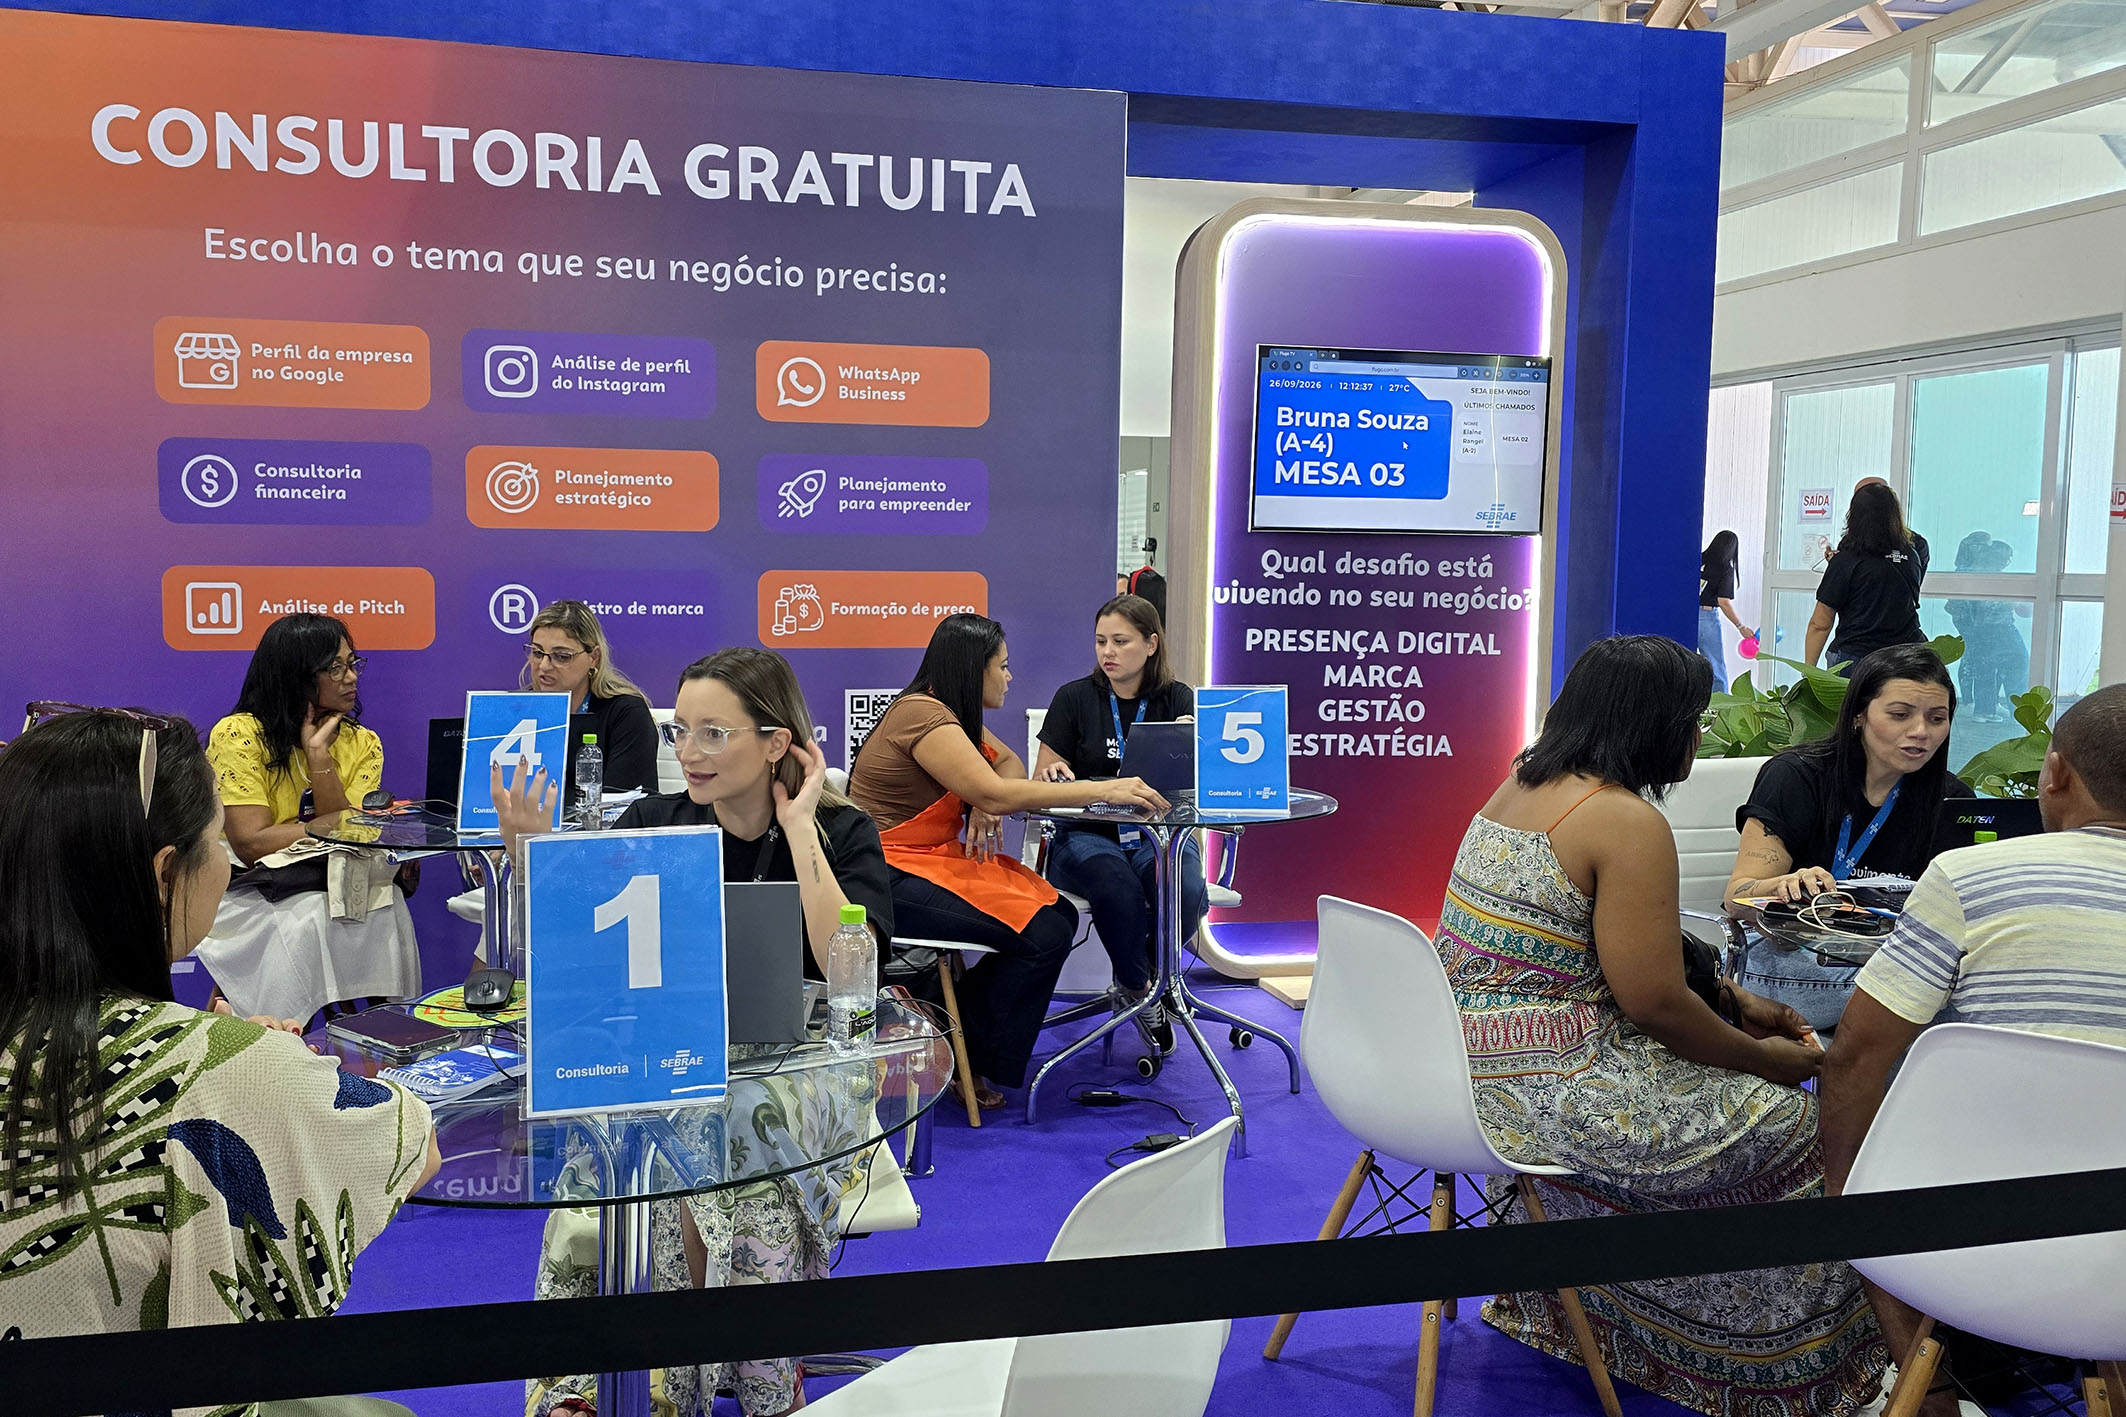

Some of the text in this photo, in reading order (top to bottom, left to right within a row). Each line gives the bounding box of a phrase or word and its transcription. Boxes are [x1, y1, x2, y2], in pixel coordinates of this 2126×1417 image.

[91, 104, 1037, 217] CONSULTORIA GRATUITA
[205, 228, 946, 296] Escolha o tema que seu negócio precisa:
[251, 343, 413, 365] Perfil da empresa
[551, 354, 691, 376] Análise de perfil
[251, 367, 344, 385] no Google
[838, 366, 920, 384] WhatsApp
[551, 376, 666, 395] do Instagram
[838, 386, 906, 400] Business
[1269, 379, 1410, 392] 26/09/2026 12:12:37 27°C
[1276, 406, 1429, 431] Bruna Souza
[1275, 431, 1334, 457] (A-4)
[254, 463, 362, 480] Consultoria
[554, 470, 673, 487] Planejamento
[1275, 460, 1406, 487] MESA 03
[255, 484, 347, 500] financeira
[838, 477, 947, 494] Planejamento
[554, 491, 652, 509] estratégico
[838, 498, 972, 515] para empreender
[1803, 493, 1830, 507] SAÍDA
[1475, 511, 1517, 521] SEBRAE
[1261, 549, 1494, 580] Qual desafio está
[1214, 579, 1533, 615] vivendo no seu negócio?
[259, 599, 405, 615] Análise de Pitch
[627, 601, 647, 615] de
[652, 604, 704, 616] marca
[831, 602, 907, 619] Formação
[911, 602, 930, 615] de
[1246, 628, 1501, 659] PRESENÇA DIGITAL
[1323, 665, 1423, 688] MARCA
[1318, 693, 1426, 723] GESTÃO
[1220, 711, 1265, 764] 5
[1288, 727, 1453, 757] ESTRATÉGIA
[489, 718, 542, 776] 4
[1208, 789, 1242, 797] Consultoria
[1956, 815, 1995, 824] DATEN
[594, 874, 662, 989] 1
[556, 1062, 629, 1079] Consultoria
[660, 1055, 704, 1069] SEBRAE
